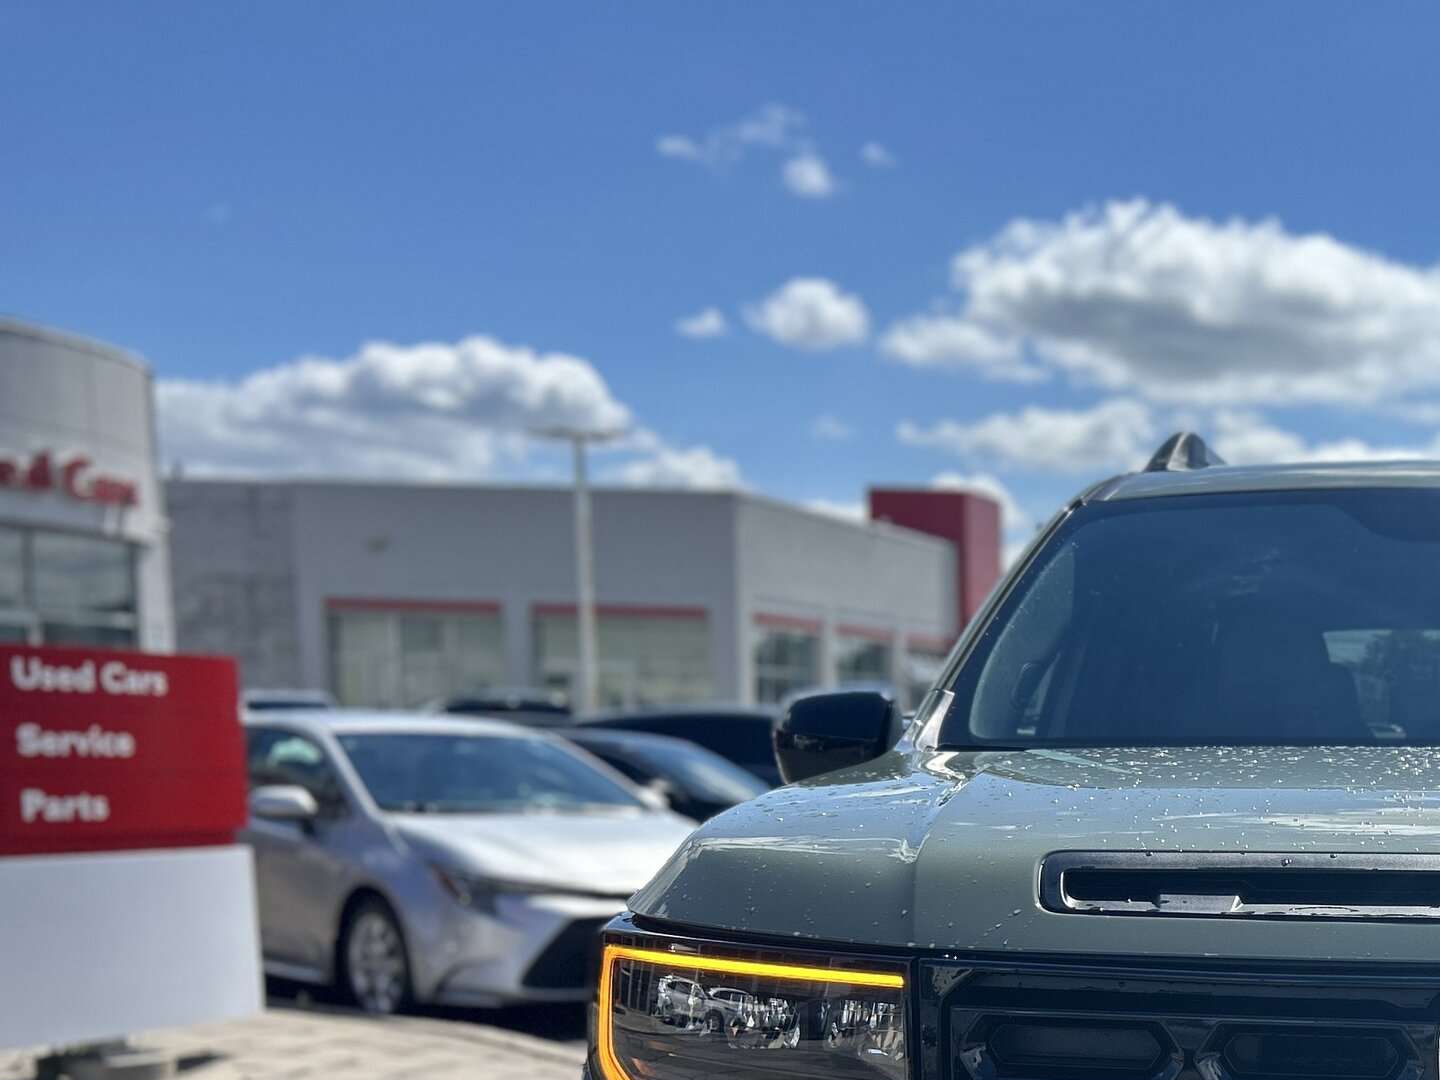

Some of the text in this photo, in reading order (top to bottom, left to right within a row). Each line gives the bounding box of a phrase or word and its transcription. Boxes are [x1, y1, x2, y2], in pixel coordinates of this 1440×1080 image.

[10, 655, 169, 697] Used Cars
[16, 722, 136, 758] Service
[20, 787, 110, 823] Parts
